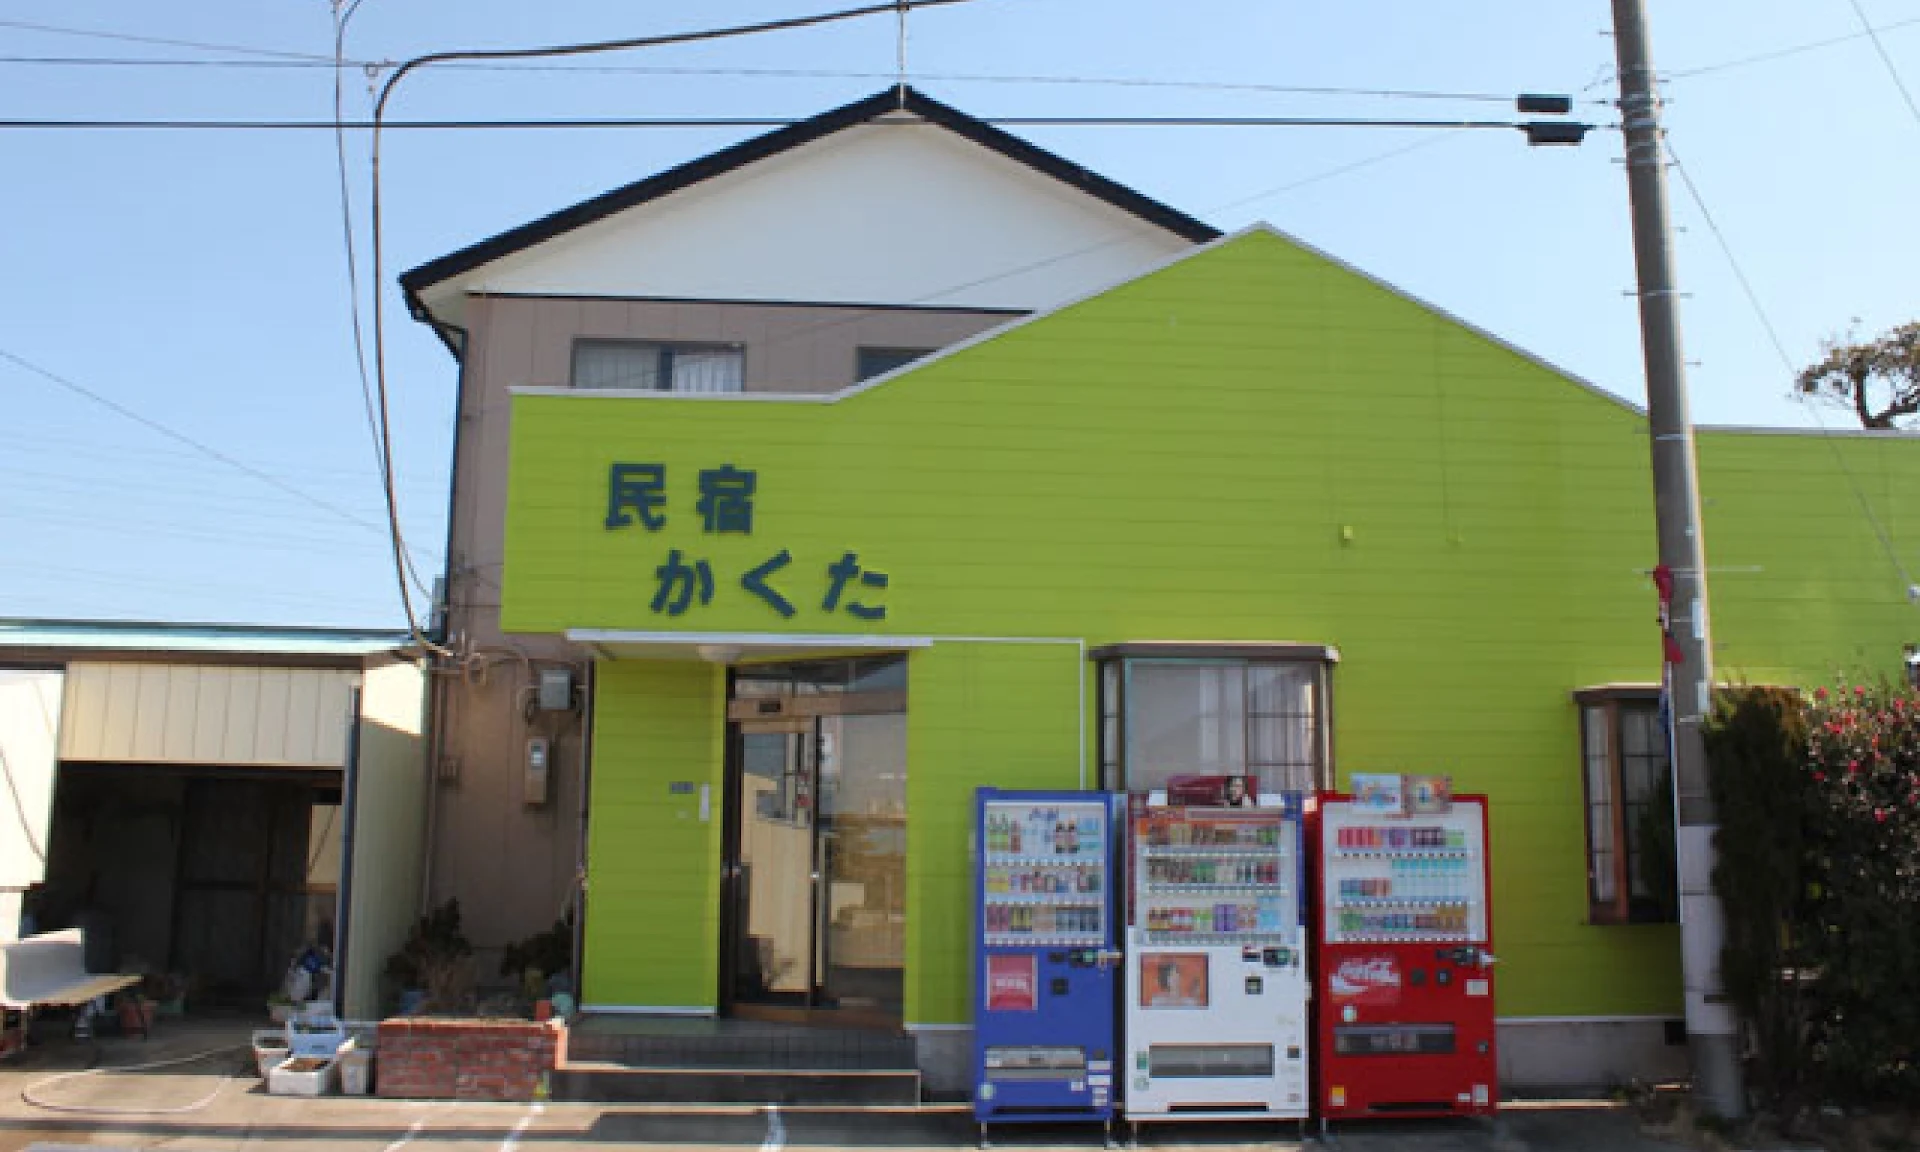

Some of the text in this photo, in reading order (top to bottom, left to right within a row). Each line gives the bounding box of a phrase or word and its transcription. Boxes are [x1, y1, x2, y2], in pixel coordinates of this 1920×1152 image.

[604, 462, 757, 535] 民宿
[650, 549, 889, 620] かくた
